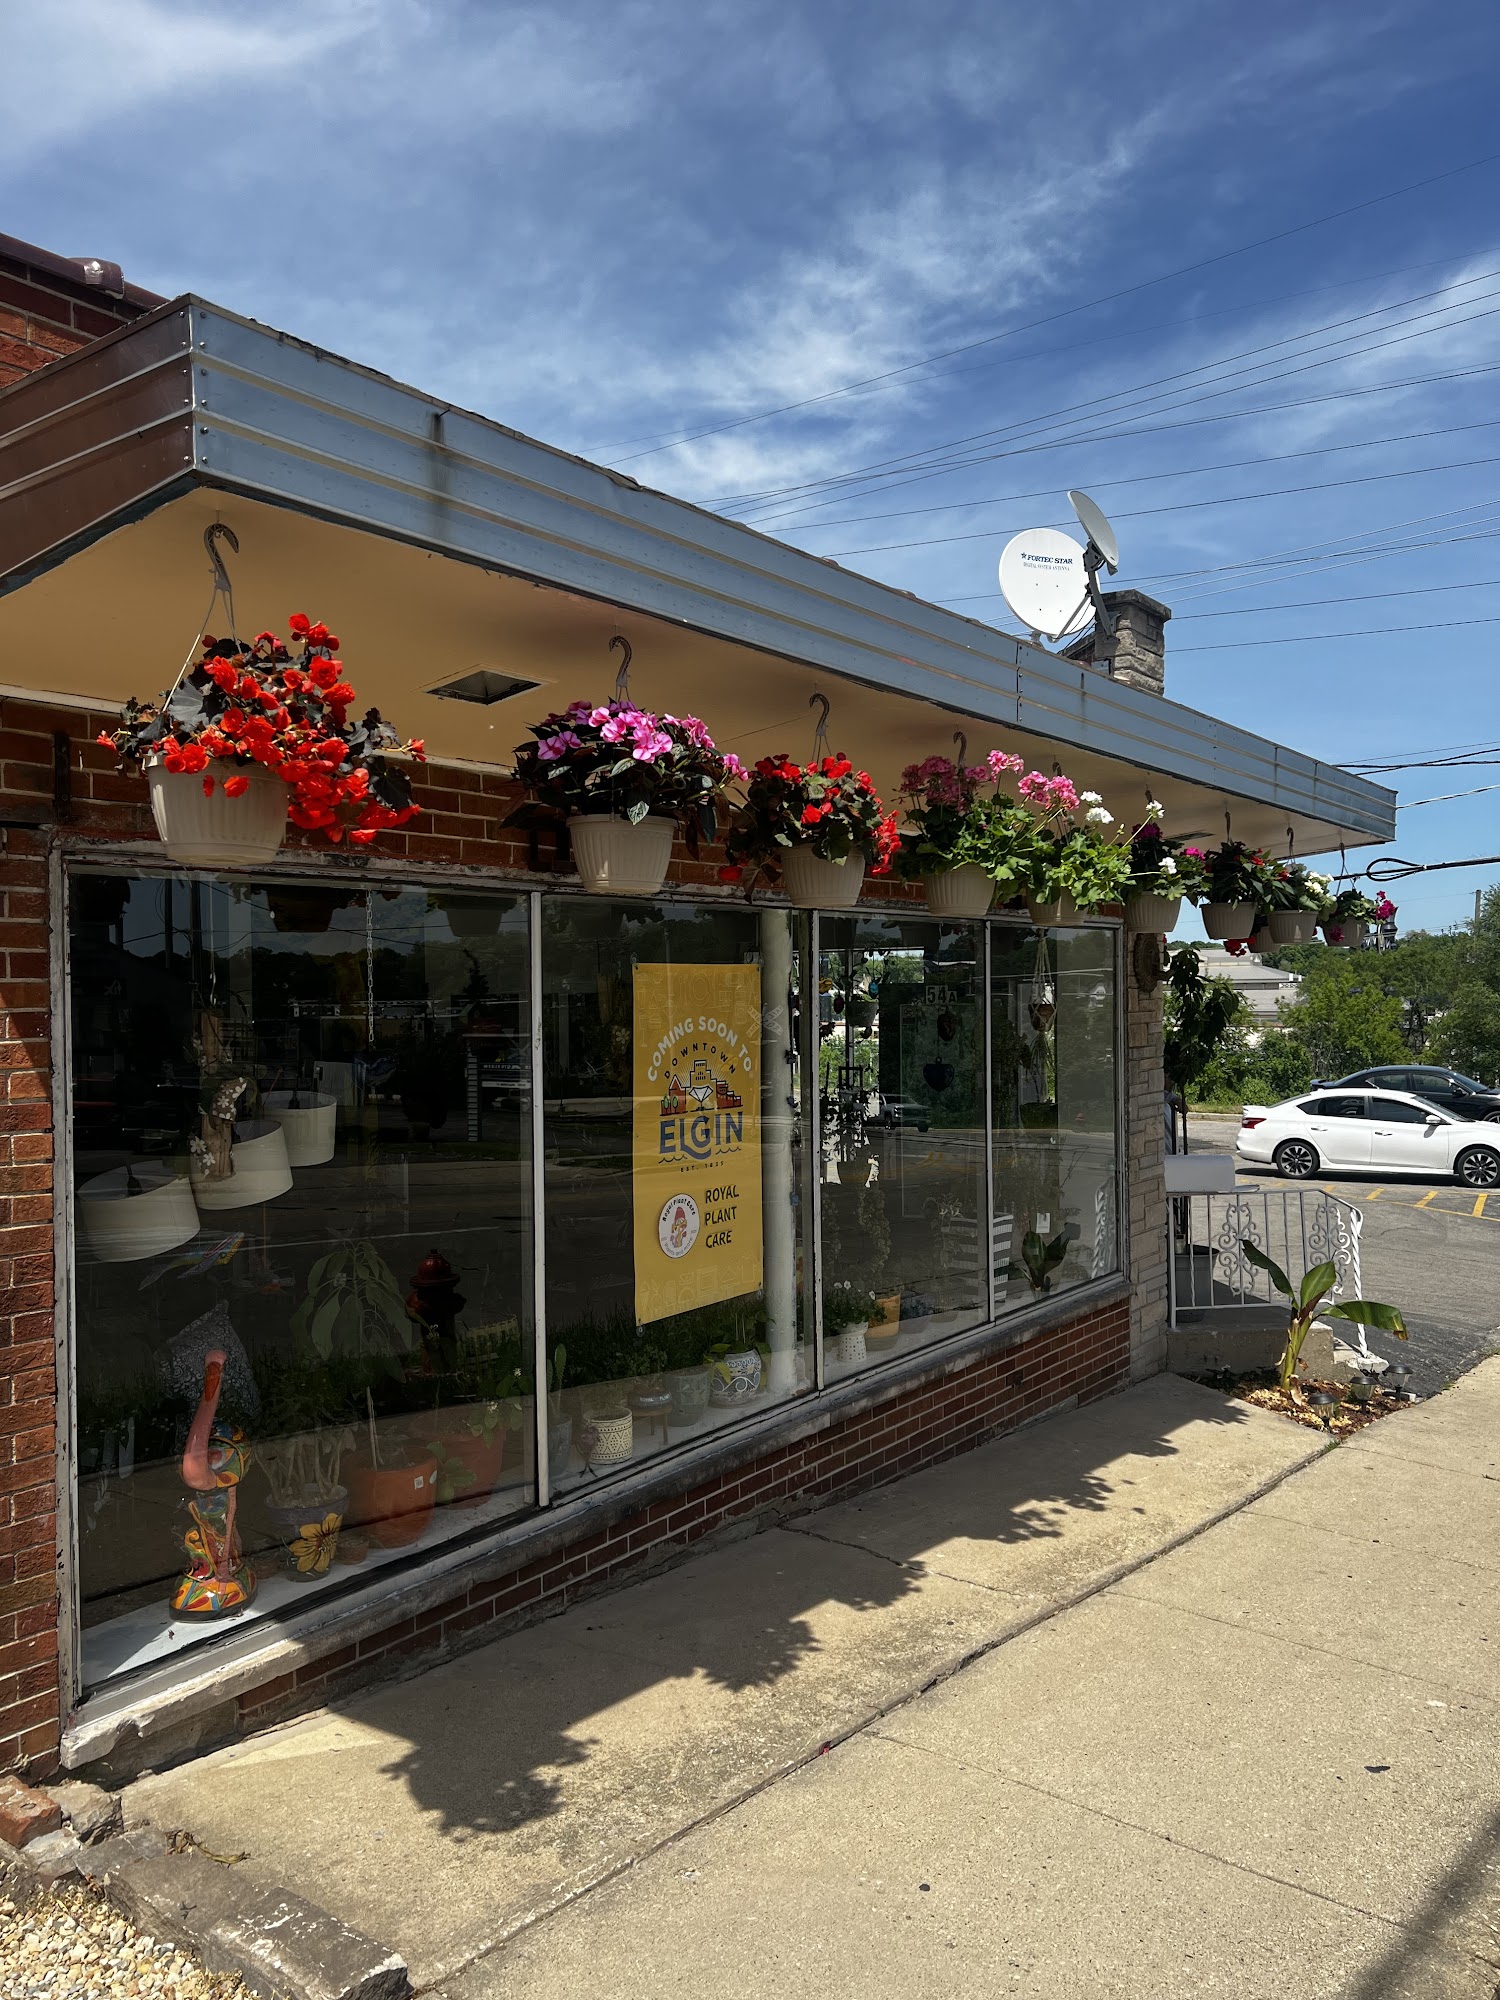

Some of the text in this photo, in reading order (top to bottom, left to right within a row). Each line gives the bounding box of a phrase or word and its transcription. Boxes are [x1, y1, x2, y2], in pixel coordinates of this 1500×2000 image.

[1027, 555, 1053, 563] FORTEC
[648, 1016, 752, 1081] COMING SOON TO
[664, 1042, 736, 1079] DOWNTOWN
[659, 1111, 743, 1160] ELGIN
[680, 1165, 699, 1173] EST.
[705, 1184, 740, 1204] ROYAL
[662, 1202, 674, 1222] Royal
[705, 1206, 737, 1226] PLANT
[705, 1230, 732, 1249] CARE
